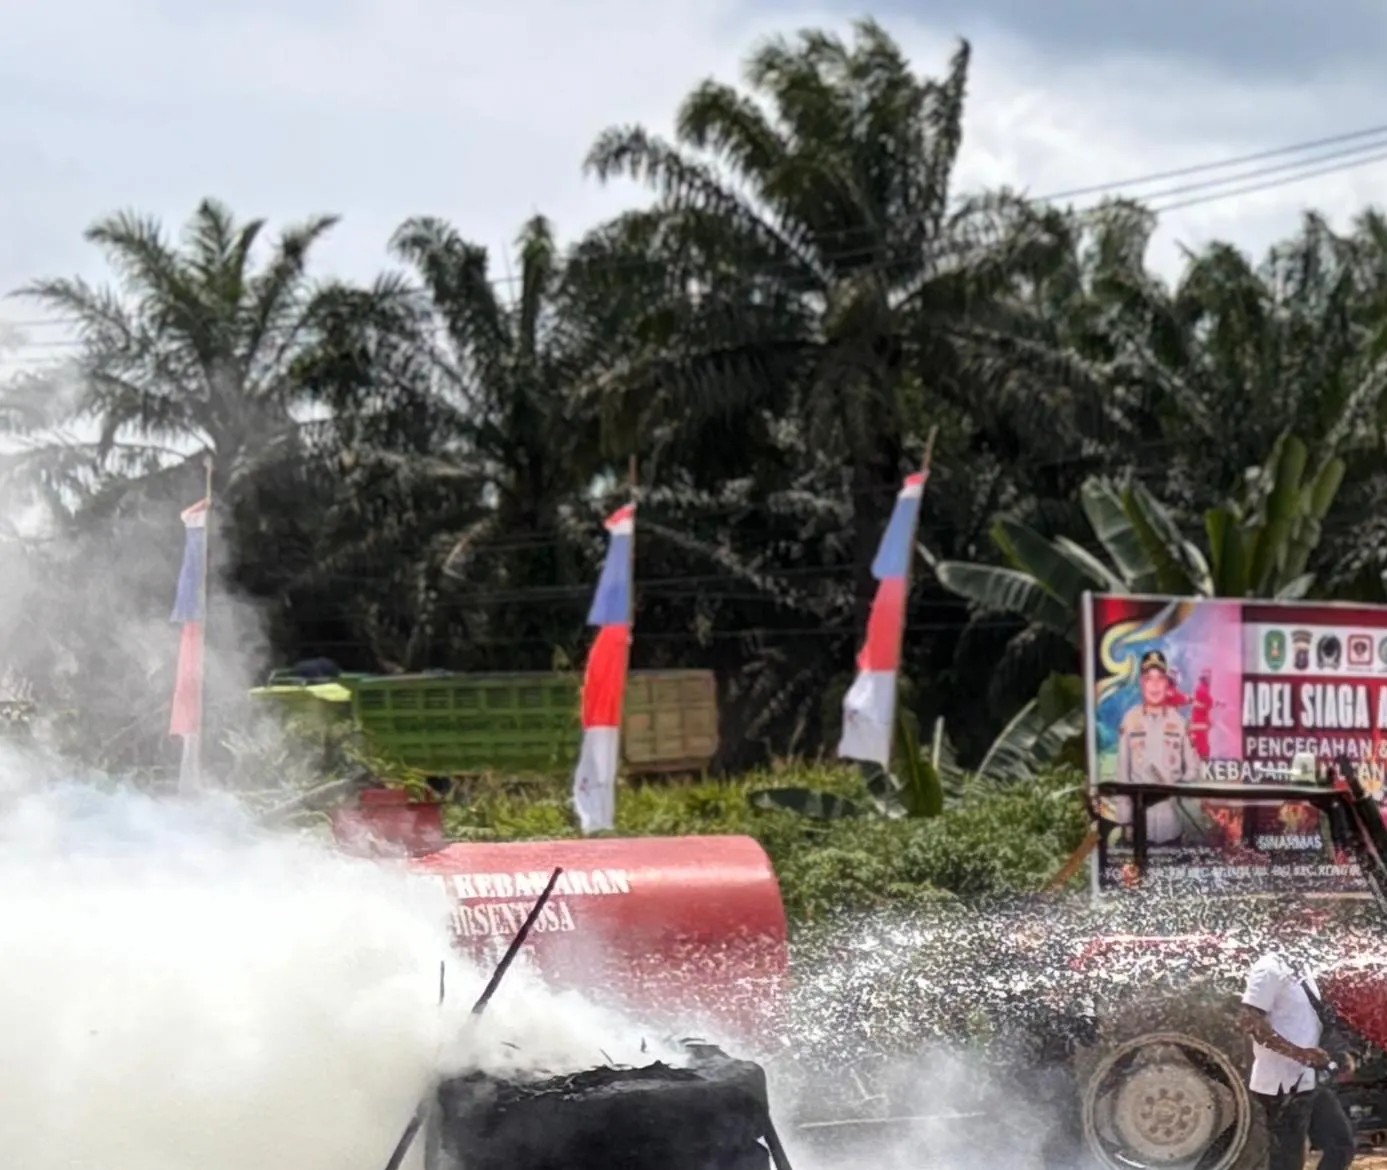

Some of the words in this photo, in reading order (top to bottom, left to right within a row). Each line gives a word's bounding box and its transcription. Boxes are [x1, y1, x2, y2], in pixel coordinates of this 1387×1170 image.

[1243, 681, 1295, 729] APEL
[1300, 682, 1371, 730] SIAGA
[1246, 736, 1372, 758] PENCEGAHAN
